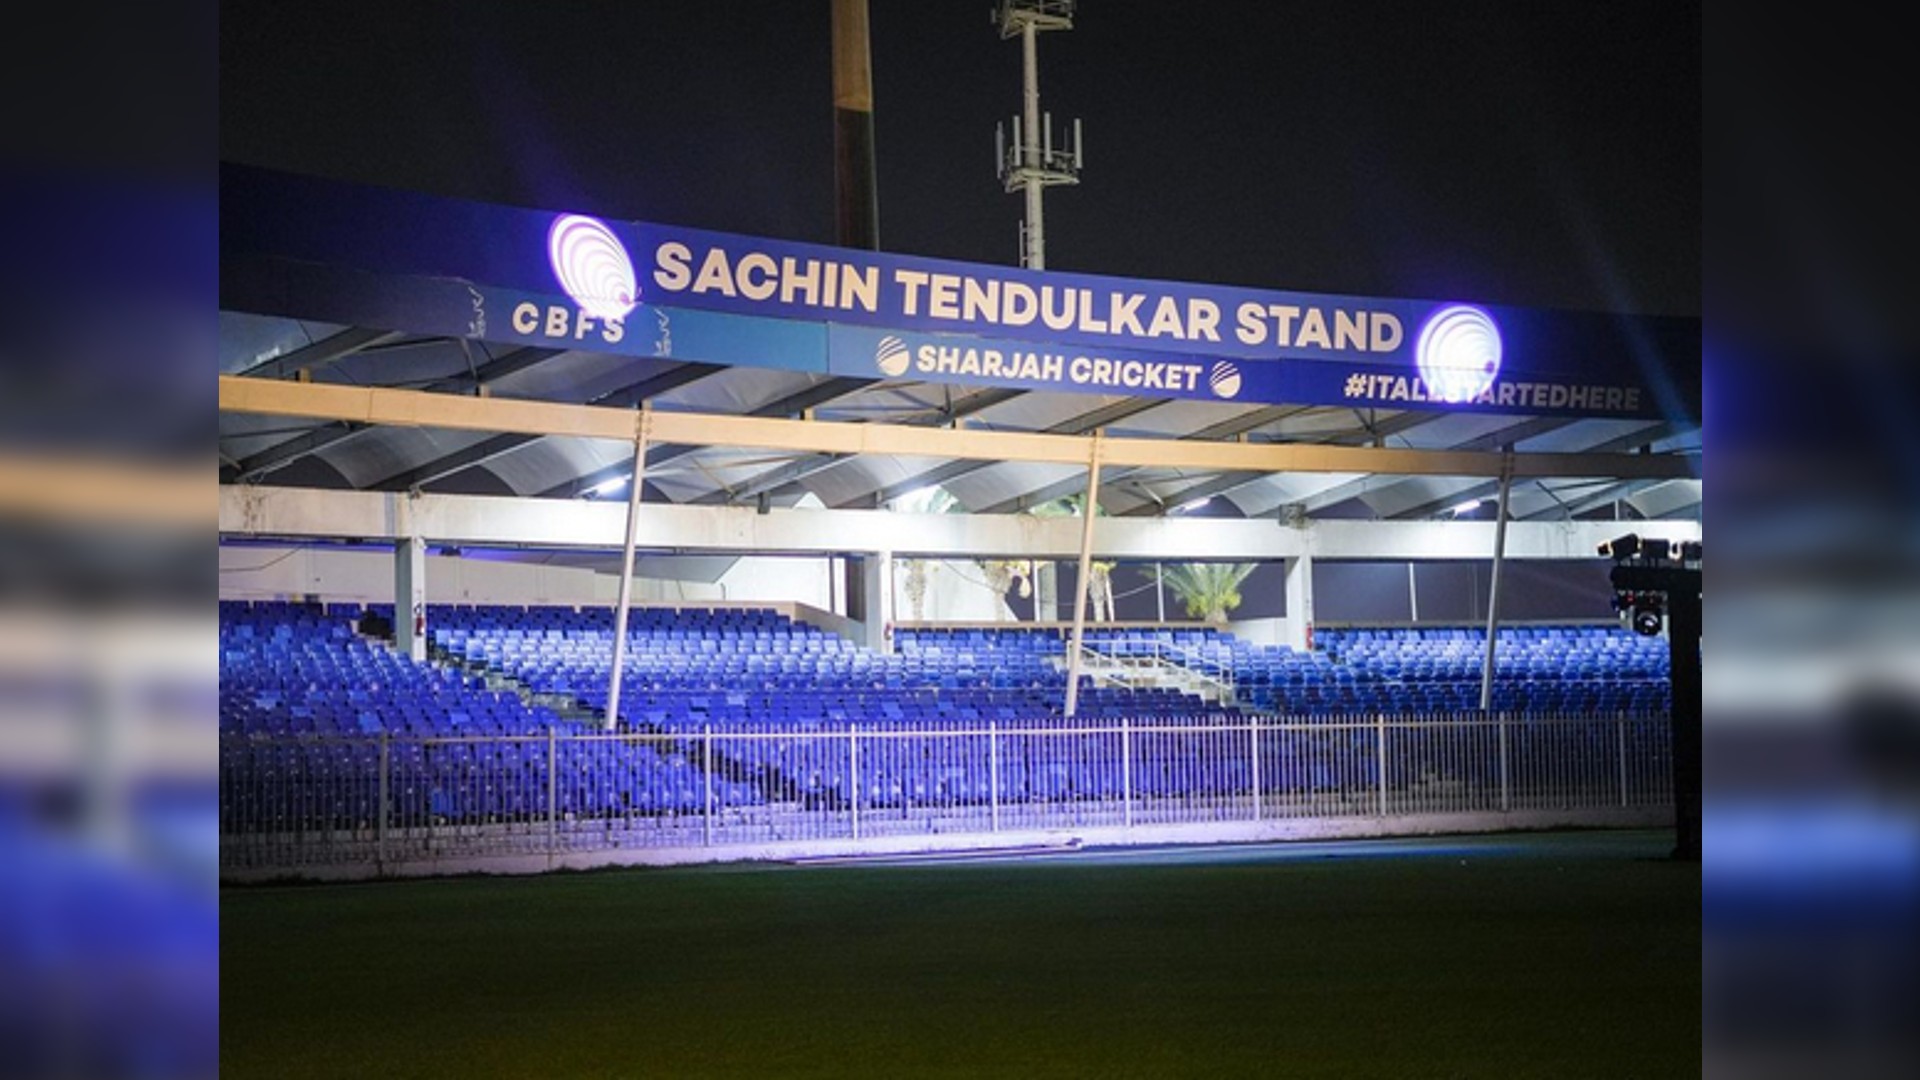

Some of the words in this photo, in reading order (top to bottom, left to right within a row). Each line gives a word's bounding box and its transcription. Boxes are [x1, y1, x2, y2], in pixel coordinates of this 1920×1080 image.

[653, 242, 879, 312] SACHIN
[895, 269, 1221, 342] TENDULKAR
[1235, 302, 1404, 353] STAND
[512, 302, 625, 343] CBFS
[916, 345, 1063, 381] SHARJAH
[1069, 359, 1203, 391] CRICKET
